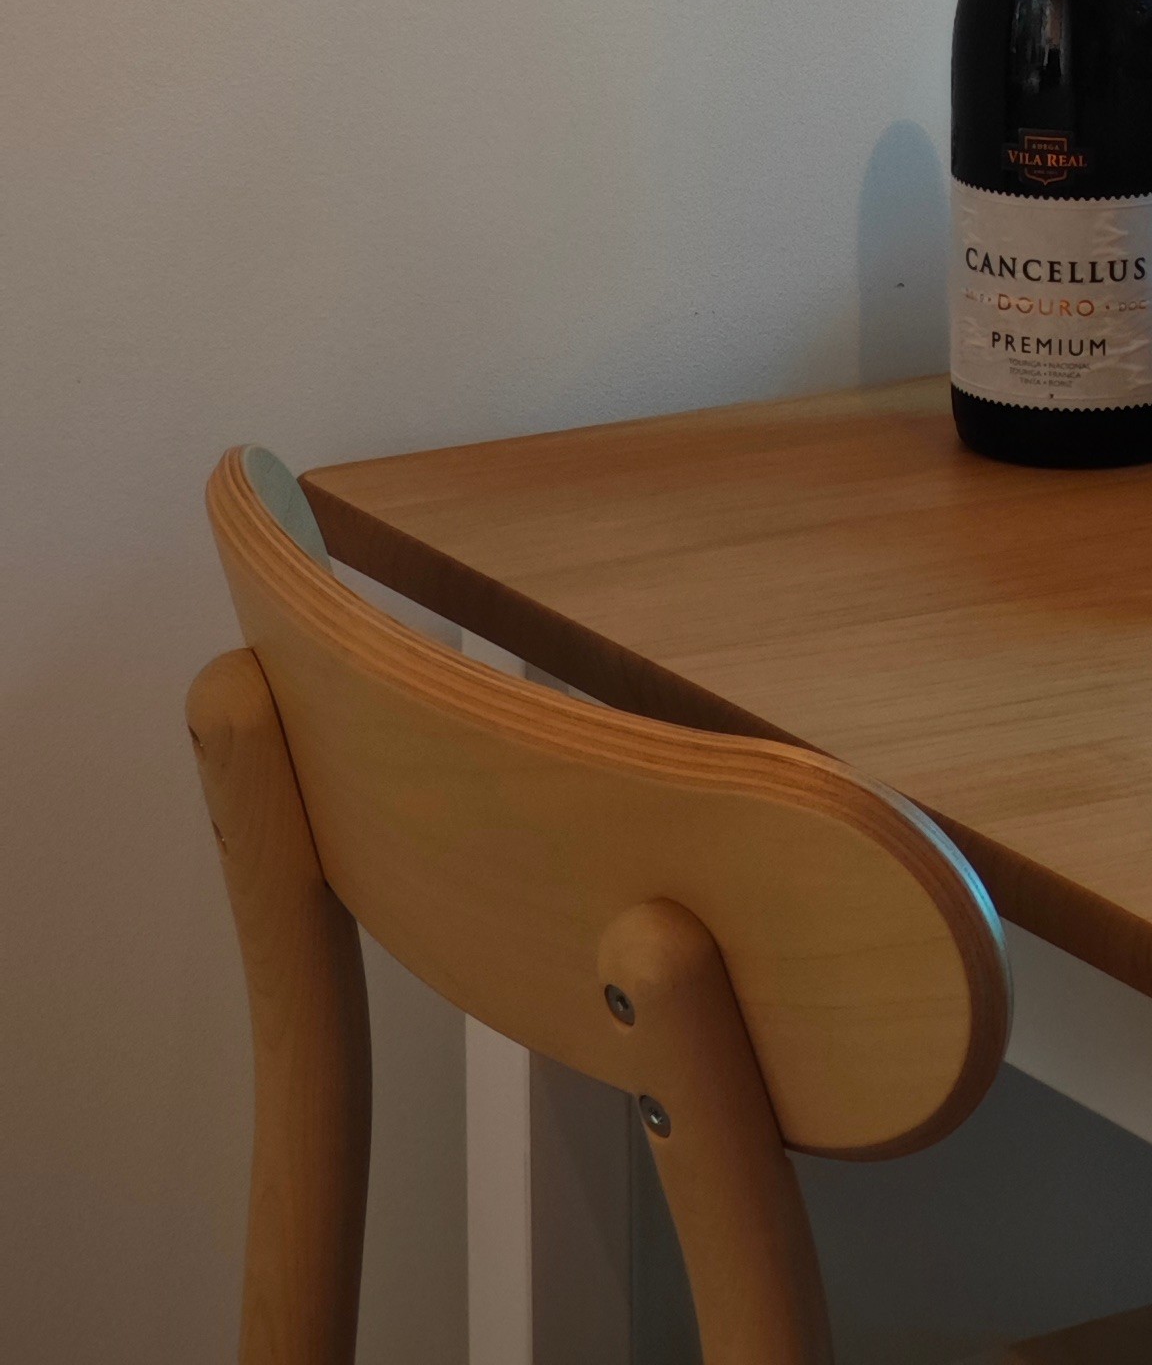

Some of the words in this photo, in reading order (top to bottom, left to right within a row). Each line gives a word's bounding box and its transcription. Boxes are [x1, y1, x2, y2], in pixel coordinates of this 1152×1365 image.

[1008, 149, 1043, 166] VILA
[1046, 153, 1088, 168] REAL
[965, 246, 1148, 284] CANCELLUS
[996, 293, 1096, 317] DOURO
[991, 330, 1107, 357] PREMIUM
